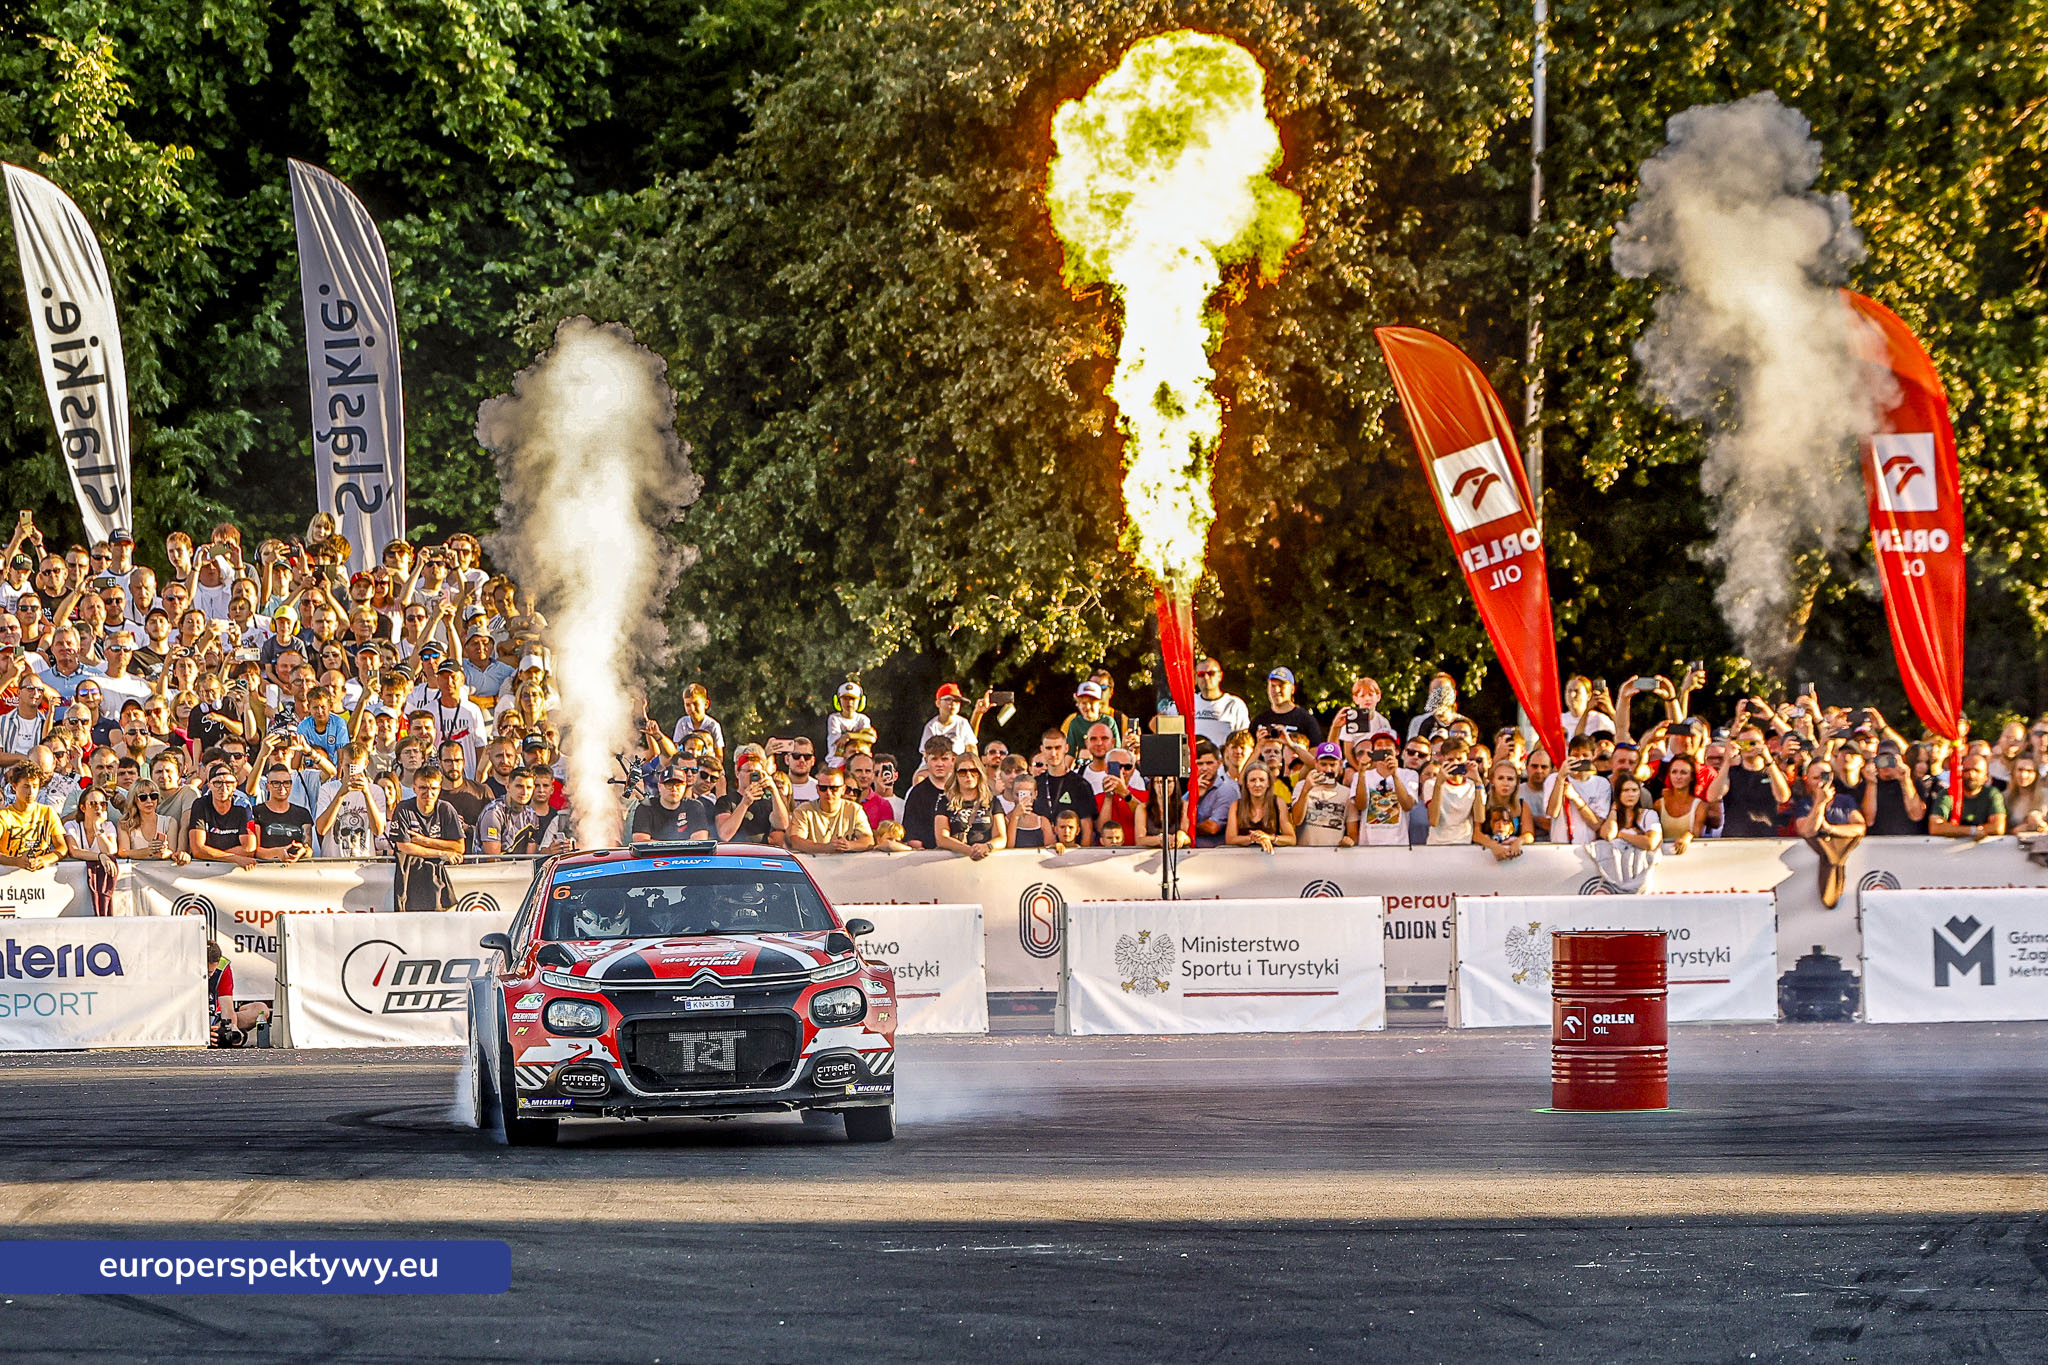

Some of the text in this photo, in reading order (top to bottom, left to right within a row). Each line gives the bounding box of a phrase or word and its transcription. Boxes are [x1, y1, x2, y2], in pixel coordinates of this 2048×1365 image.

[7, 885, 45, 904] ŚLĄSKI
[553, 885, 571, 900] 6
[1383, 920, 1436, 940] ADION
[1182, 936, 1300, 953] Ministerstwo
[0, 938, 124, 979] teria
[661, 954, 742, 963] Motorsport
[1667, 946, 1730, 968] rystyki
[1181, 958, 1339, 980] Sportu i Turystyki
[1592, 1013, 1635, 1024] ORLEN
[1592, 1026, 1609, 1034] OIL
[561, 1074, 605, 1082] CITROËN
[531, 1098, 572, 1106] MICHELIN
